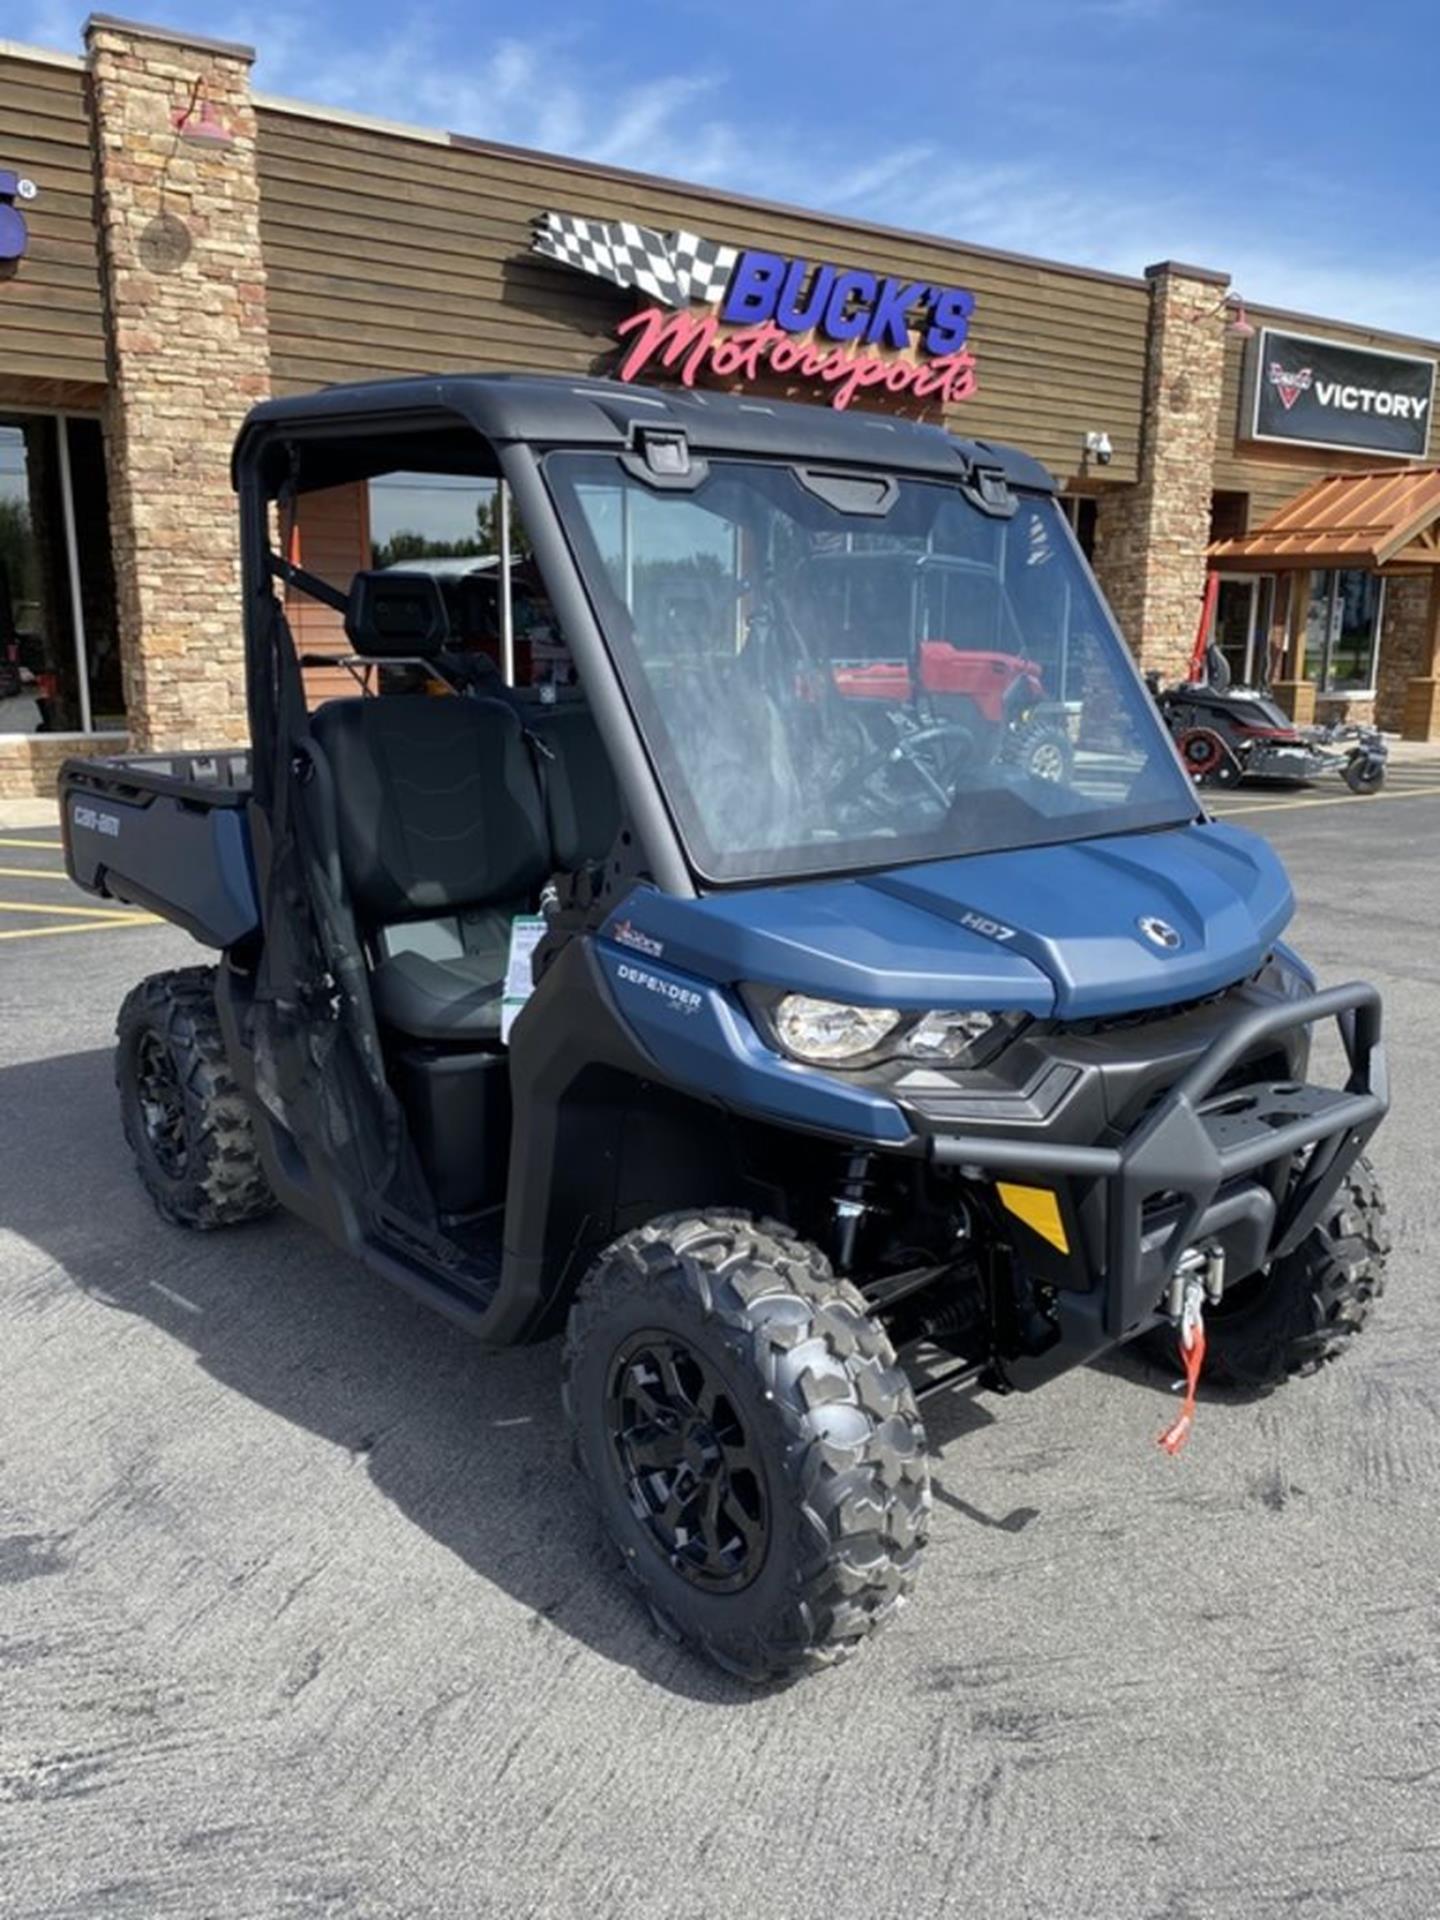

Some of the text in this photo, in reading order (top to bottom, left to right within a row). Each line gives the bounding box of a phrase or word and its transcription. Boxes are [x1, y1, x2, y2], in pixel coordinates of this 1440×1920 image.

[720, 249, 976, 355] BUCK'S
[617, 307, 978, 411] Motorsports
[1315, 380, 1428, 420] VICTORY
[960, 911, 1016, 940] HD7
[617, 964, 703, 1009] DEFENDER
